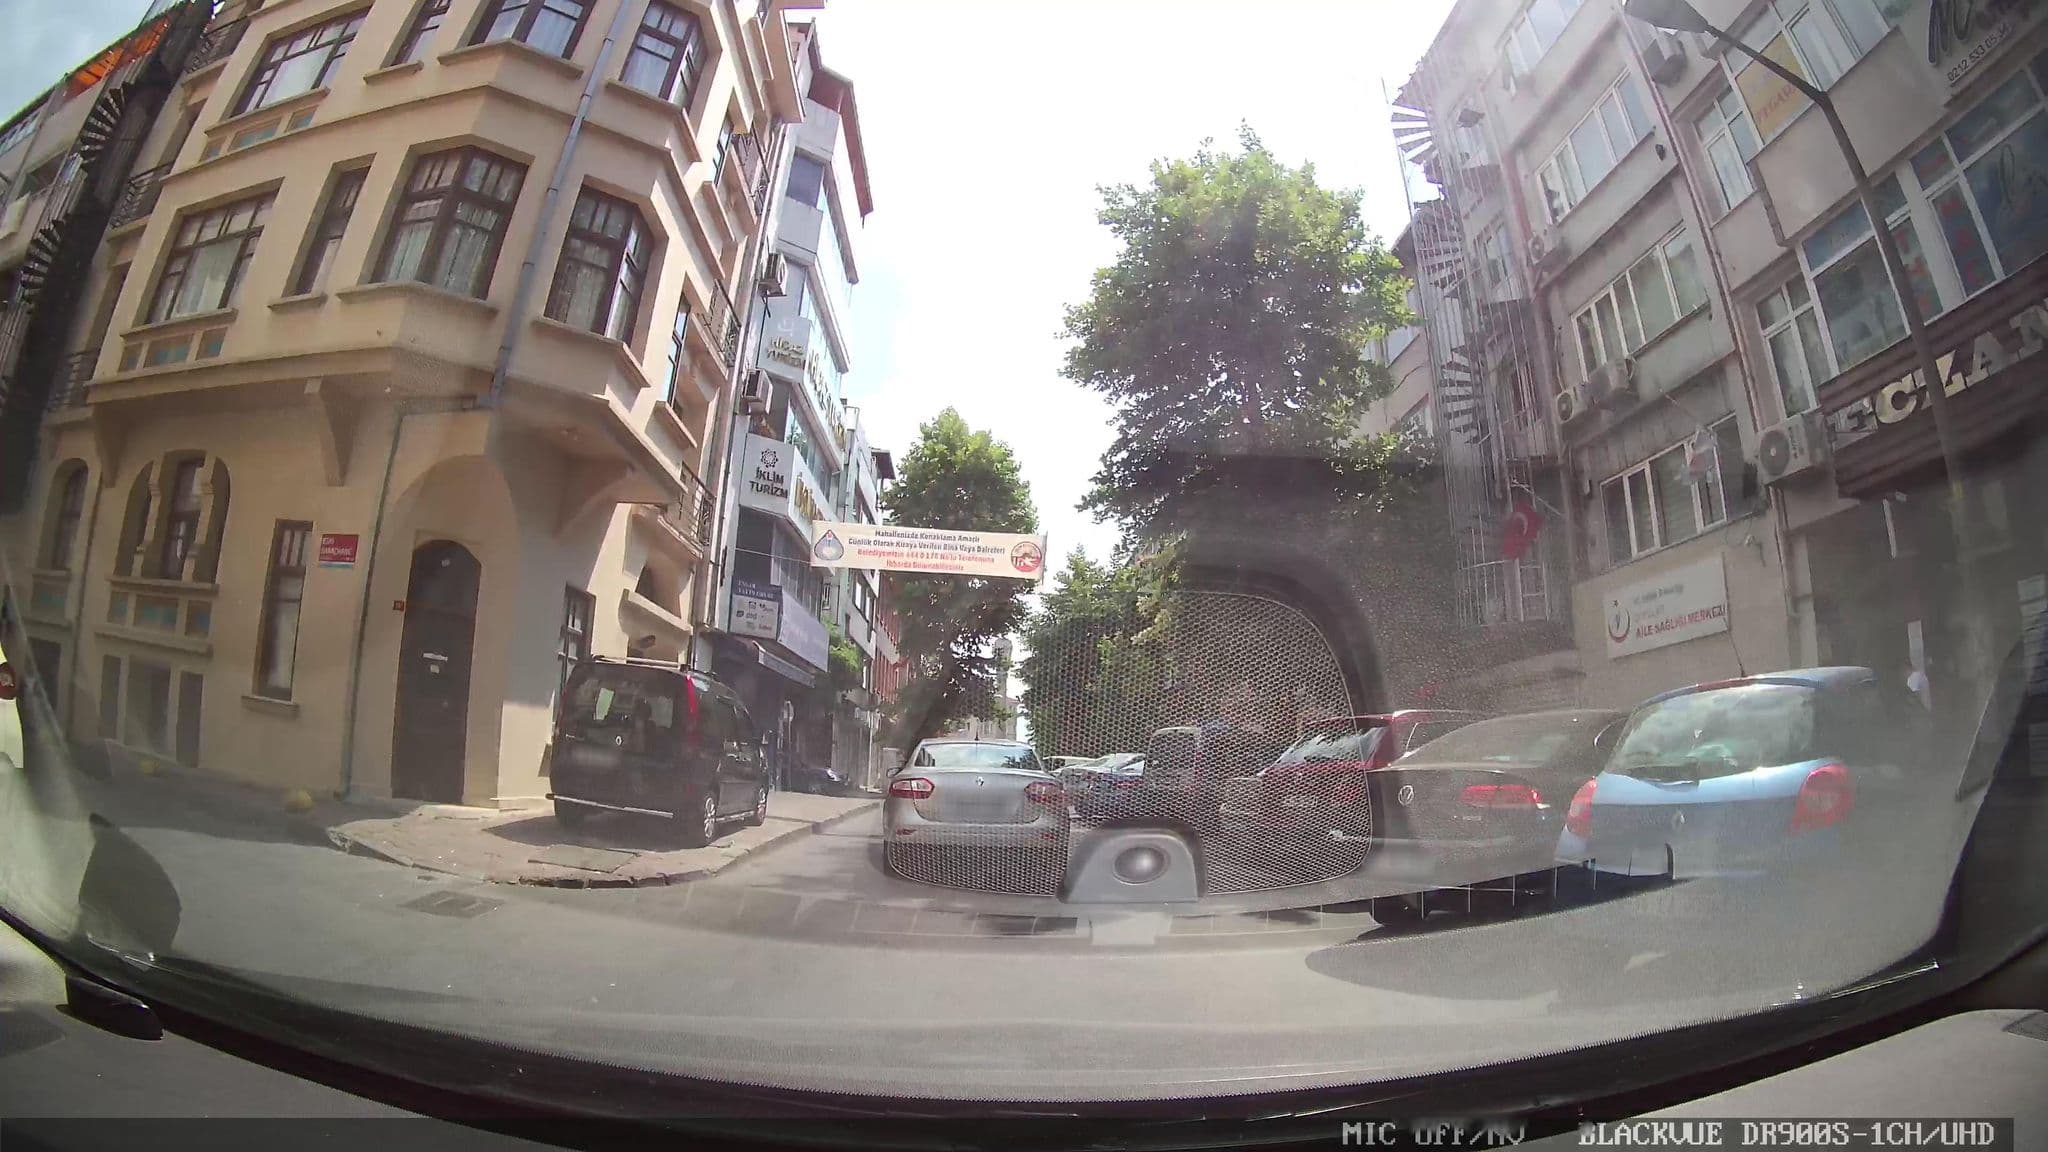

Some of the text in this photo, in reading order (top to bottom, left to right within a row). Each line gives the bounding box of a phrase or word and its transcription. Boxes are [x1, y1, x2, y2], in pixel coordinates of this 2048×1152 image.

[756, 467, 784, 484] İKLİM
[749, 480, 788, 499] TURİZM
[875, 530, 918, 539] Mahallenizde
[920, 532, 956, 542] Konaklama
[848, 538, 871, 546] Günlük
[873, 539, 895, 547] Olarak
[960, 544, 975, 553] Veya
